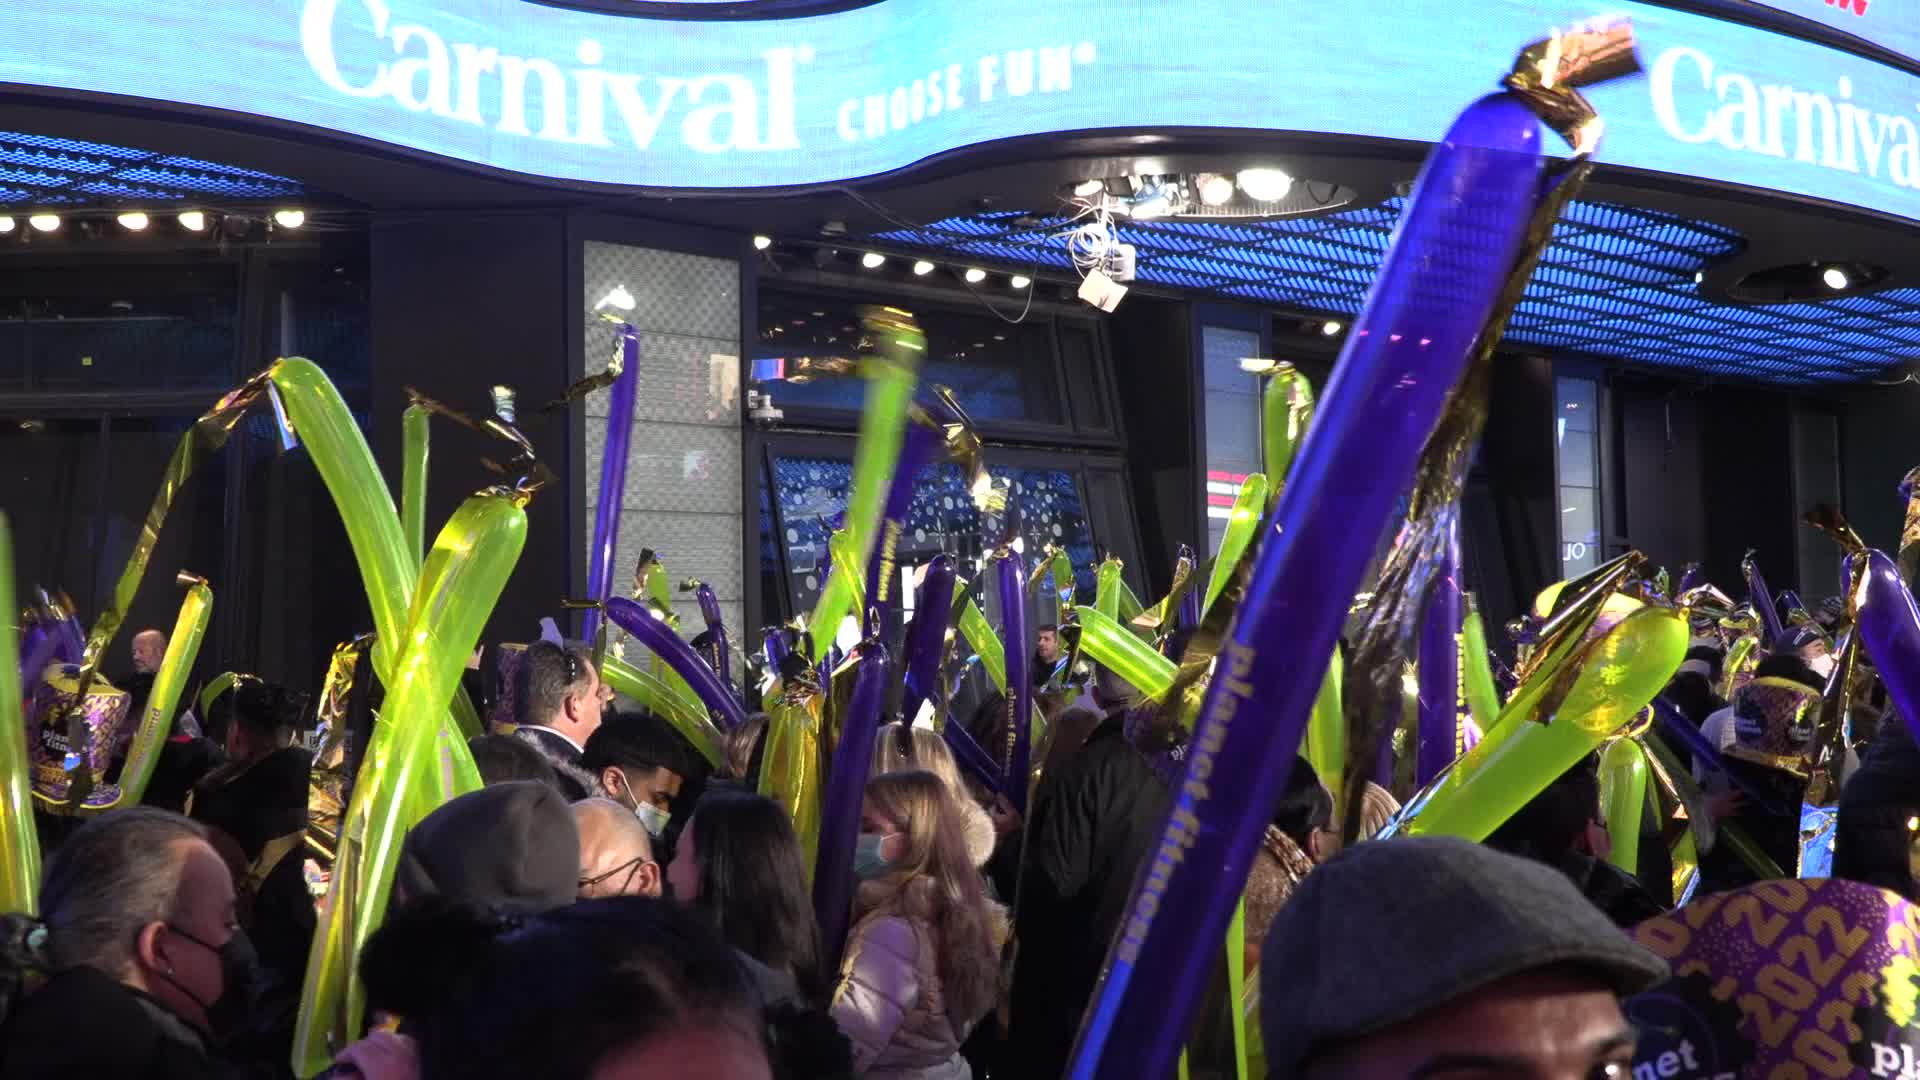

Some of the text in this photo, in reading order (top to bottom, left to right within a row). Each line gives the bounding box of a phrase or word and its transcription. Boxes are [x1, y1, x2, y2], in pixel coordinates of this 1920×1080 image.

[300, 0, 1073, 152] Carnival CHOOSE FUN
[1650, 46, 1920, 190] Carniva
[43, 729, 69, 742] plan
[1737, 904, 1871, 1048] 2022
[1632, 1037, 1699, 1080] net
[1870, 1042, 1920, 1080] pl
